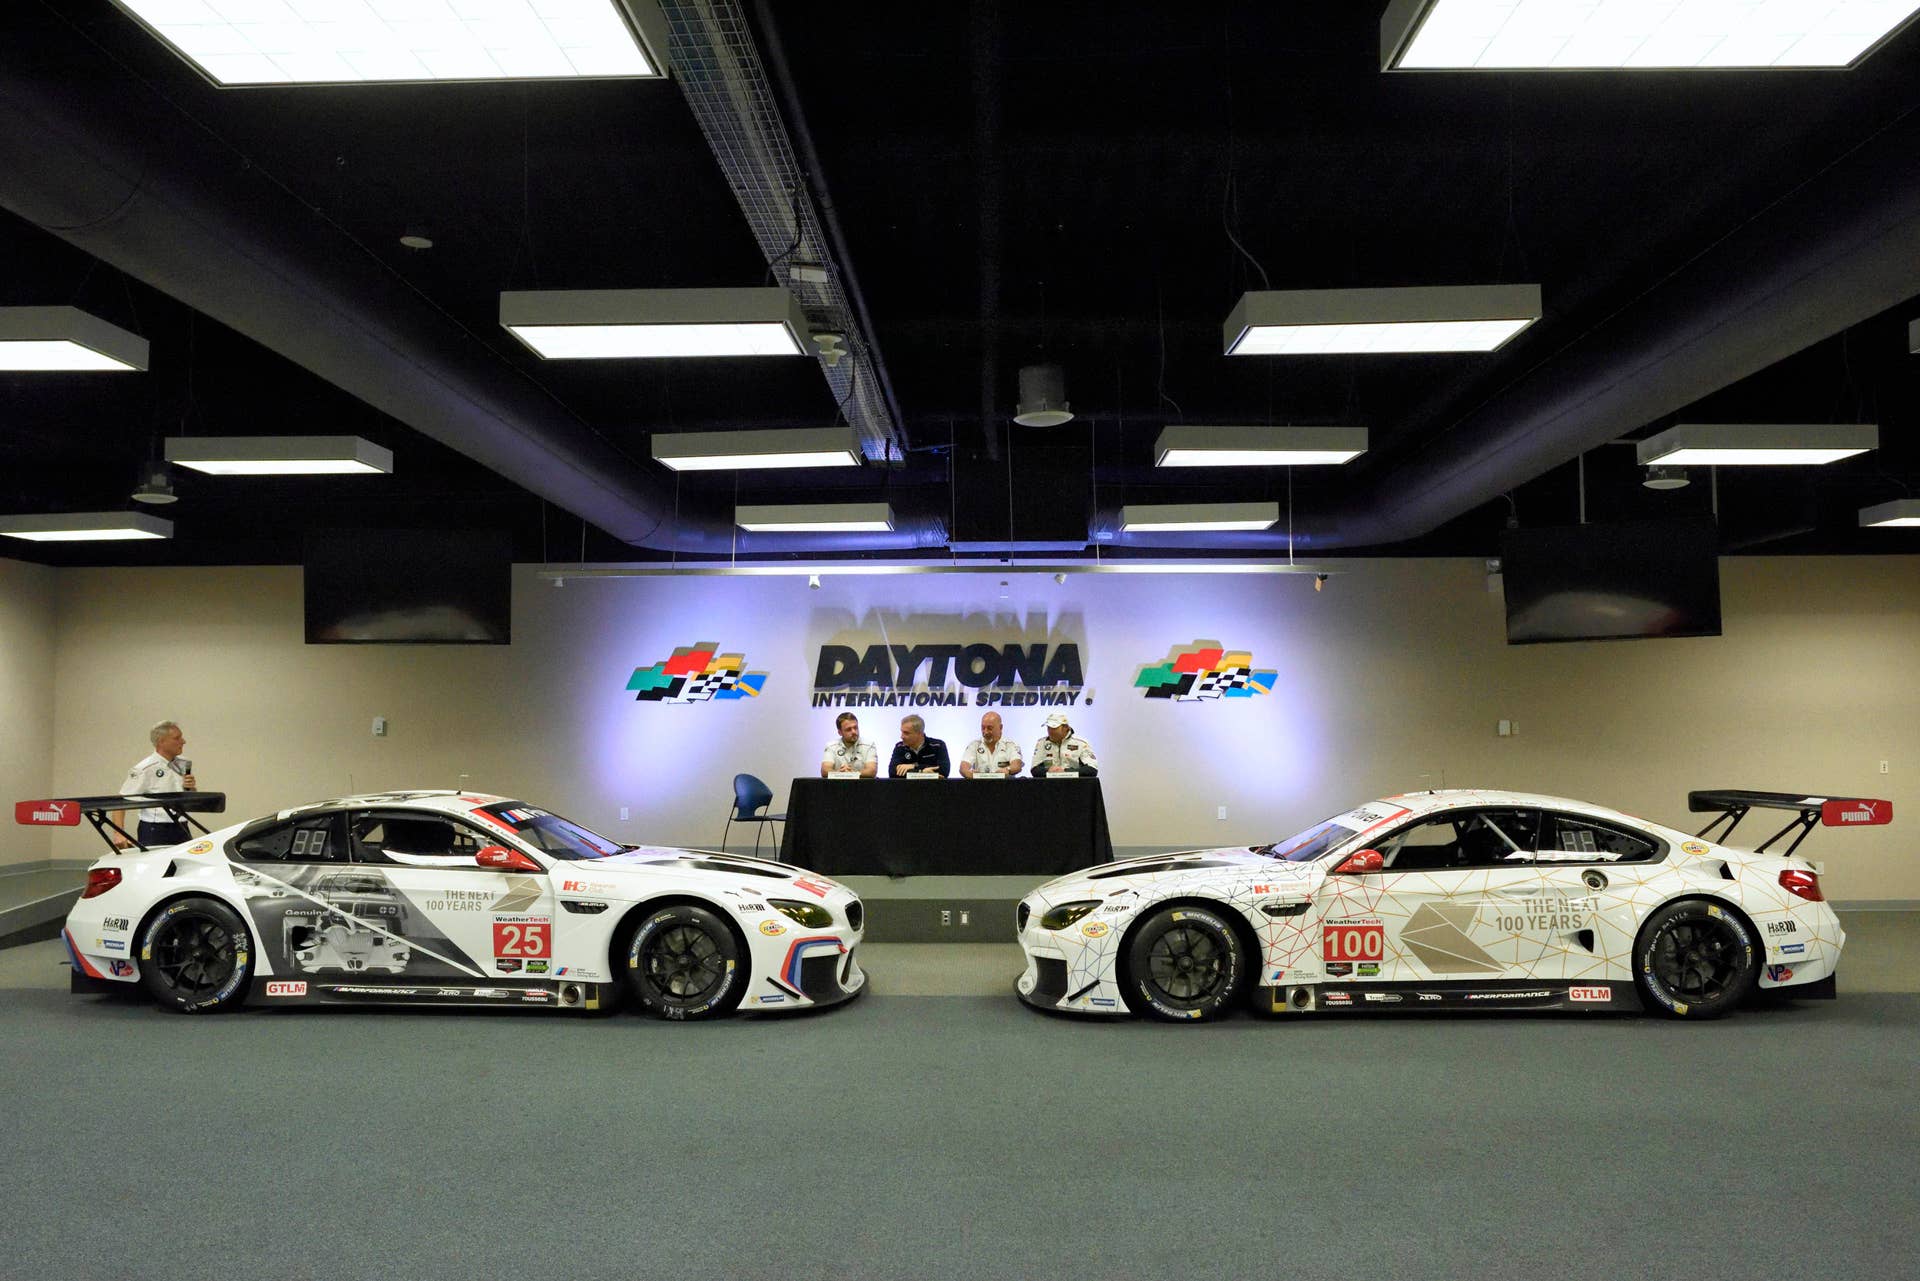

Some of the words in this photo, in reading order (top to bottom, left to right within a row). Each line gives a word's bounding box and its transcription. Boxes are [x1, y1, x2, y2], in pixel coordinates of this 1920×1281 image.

[814, 643, 1084, 688] DAYTONA
[812, 692, 968, 707] INTERNATIONAL
[976, 691, 1081, 706] SPEEDWAY
[33, 811, 59, 822] PUMA
[1841, 811, 1870, 822] PUMA
[444, 890, 466, 901] THE
[467, 890, 496, 901] NEXT
[426, 901, 444, 911] 100
[446, 901, 482, 912] YEARS
[1522, 898, 1554, 914] THE
[1558, 897, 1601, 912] NEXT
[1496, 915, 1524, 931] 100
[1528, 914, 1583, 930] YEARS
[501, 925, 544, 955] 25
[1325, 930, 1383, 958] 100
[268, 983, 306, 994] GTLM
[1571, 989, 1610, 999] GTLM
